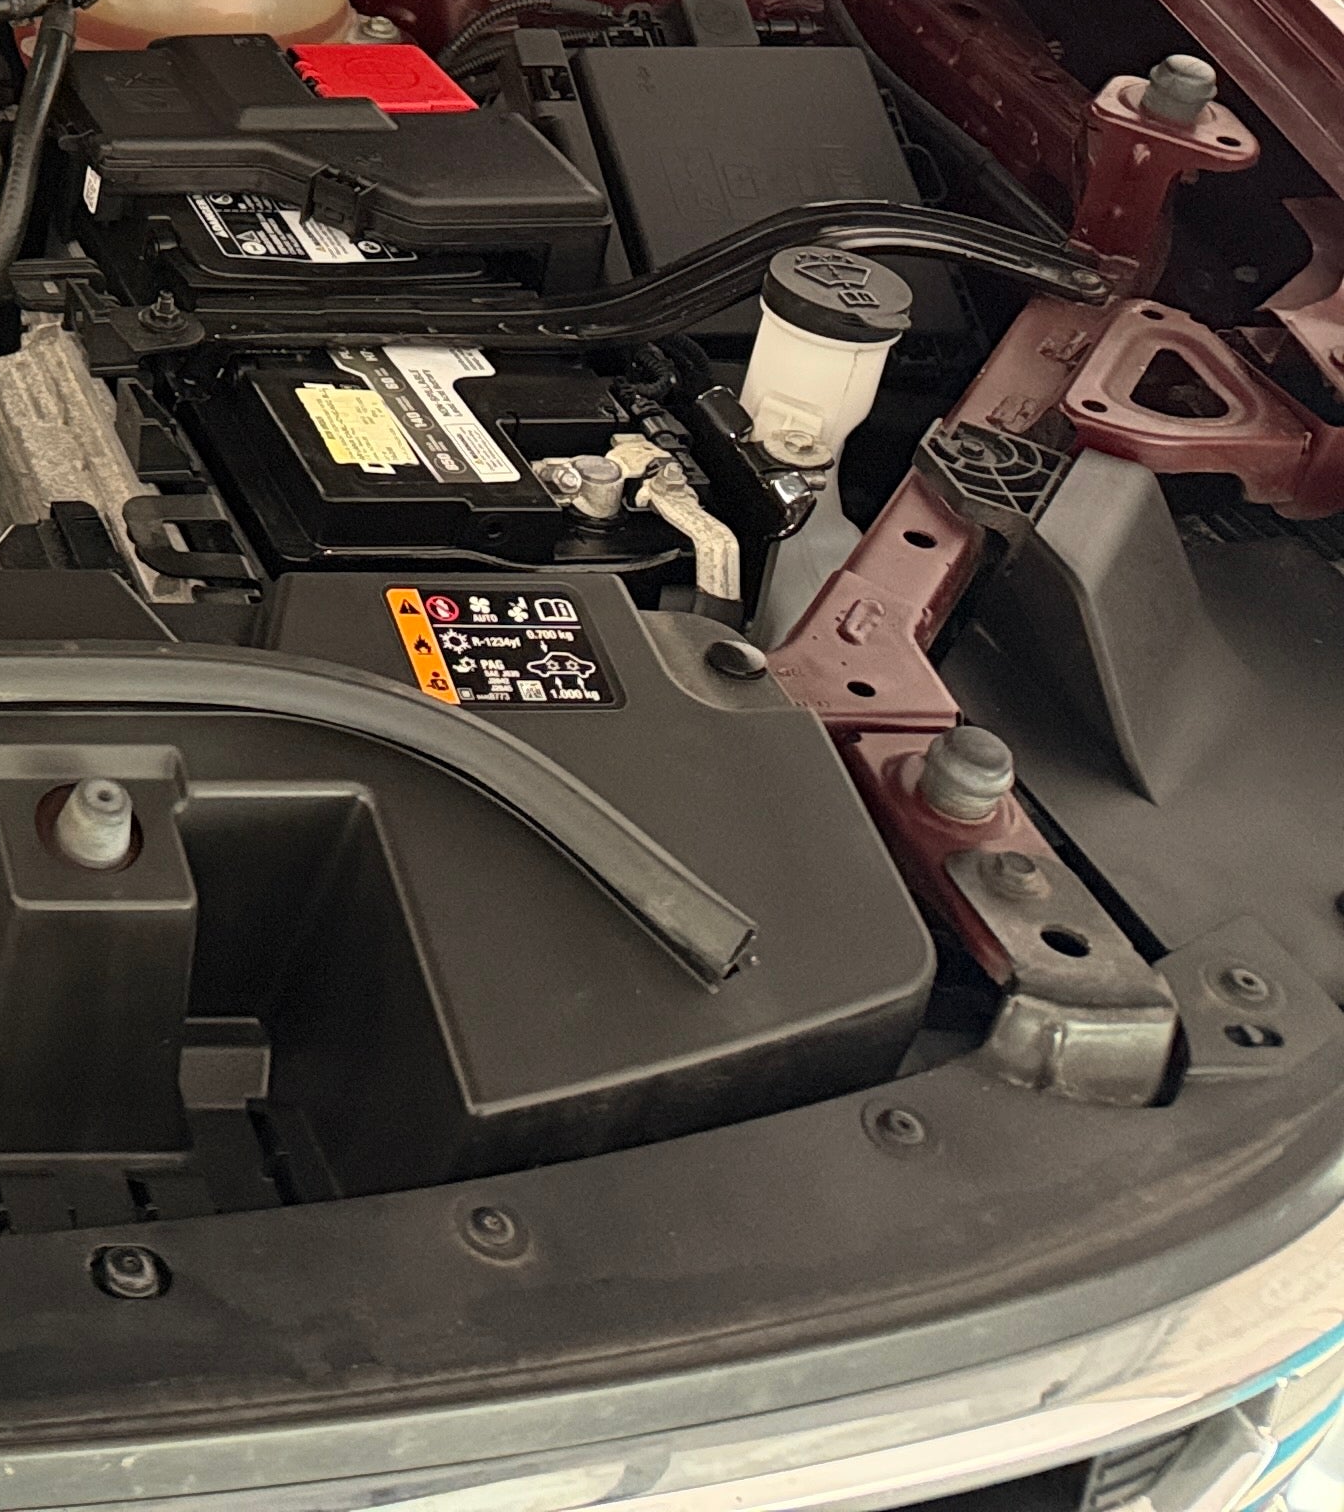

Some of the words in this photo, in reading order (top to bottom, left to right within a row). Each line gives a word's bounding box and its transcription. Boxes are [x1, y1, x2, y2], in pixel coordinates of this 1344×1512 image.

[473, 613, 499, 623] AUTO
[471, 635, 522, 649] R-1234yf
[557, 629, 575, 642] kg
[479, 659, 505, 670] PAG
[549, 688, 583, 700] 1.000
[583, 689, 601, 702] kg
